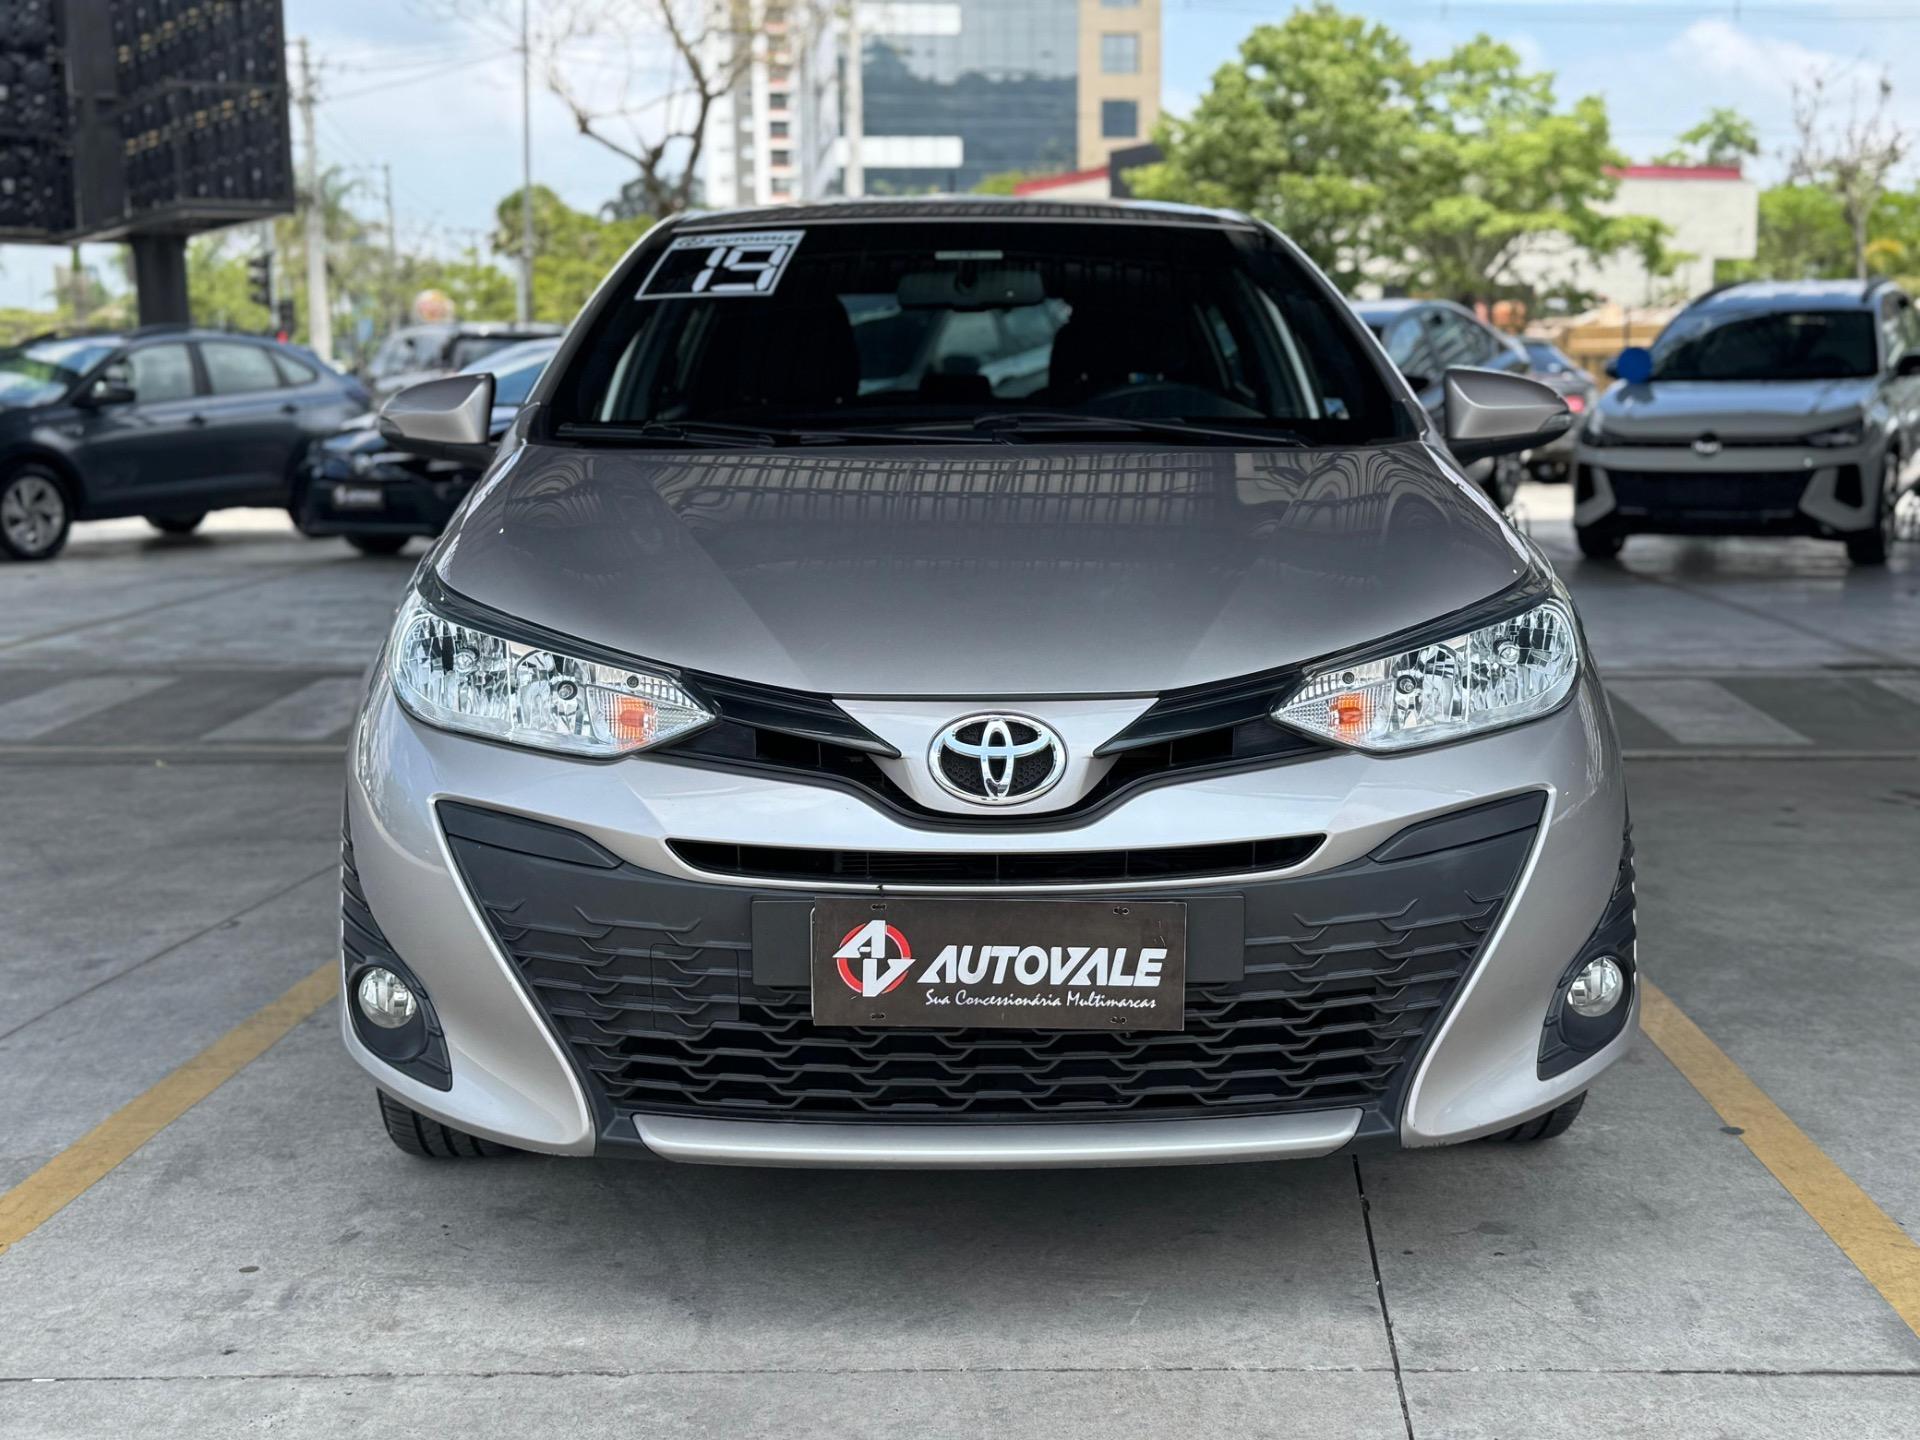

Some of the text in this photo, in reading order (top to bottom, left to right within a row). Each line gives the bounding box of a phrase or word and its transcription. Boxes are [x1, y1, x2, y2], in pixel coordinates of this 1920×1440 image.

[691, 245, 788, 293] 19
[917, 945, 1168, 987] AUTOVALE
[925, 988, 1157, 1009] Sua Concessionária Multimarcas
